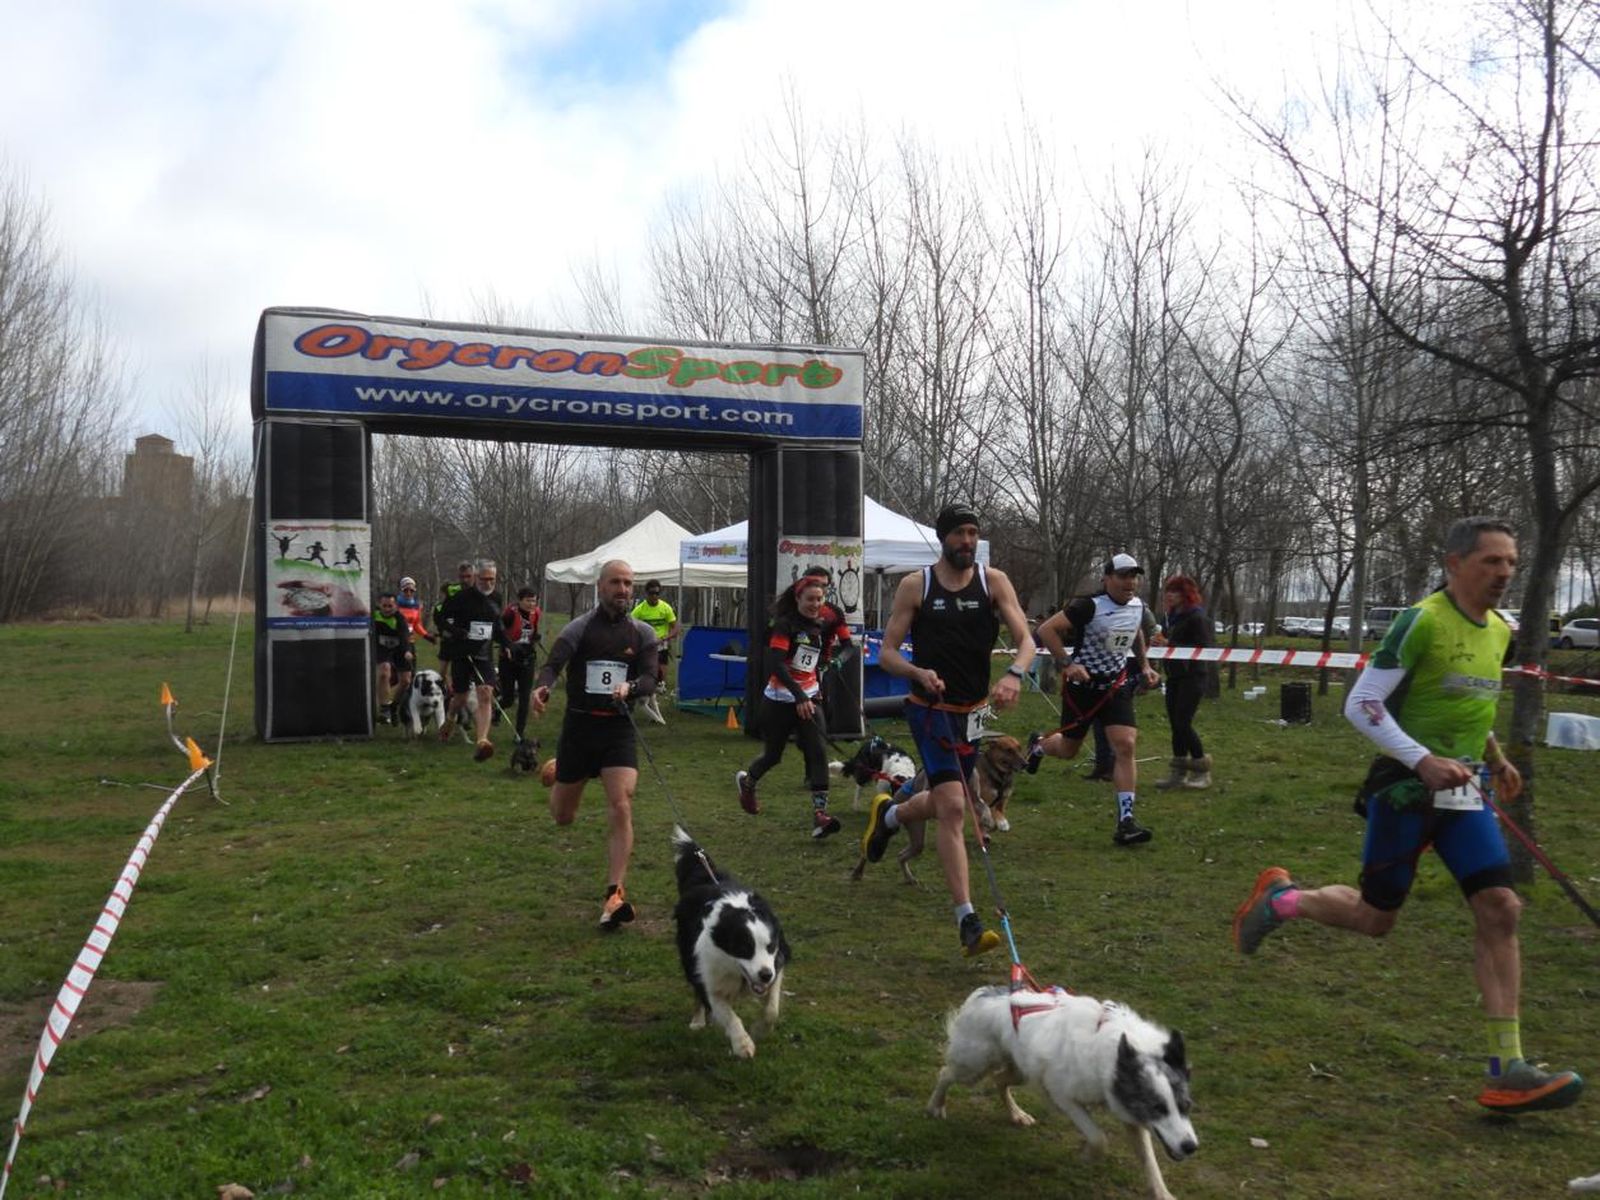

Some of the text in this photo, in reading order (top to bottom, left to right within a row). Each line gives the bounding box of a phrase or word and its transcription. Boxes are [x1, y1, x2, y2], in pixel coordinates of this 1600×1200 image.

[294, 325, 844, 390] OrycronSport
[355, 386, 795, 426] www.orycronsport.com
[1114, 635, 1129, 647] 12
[800, 653, 813, 666] 13
[601, 671, 612, 685] 8
